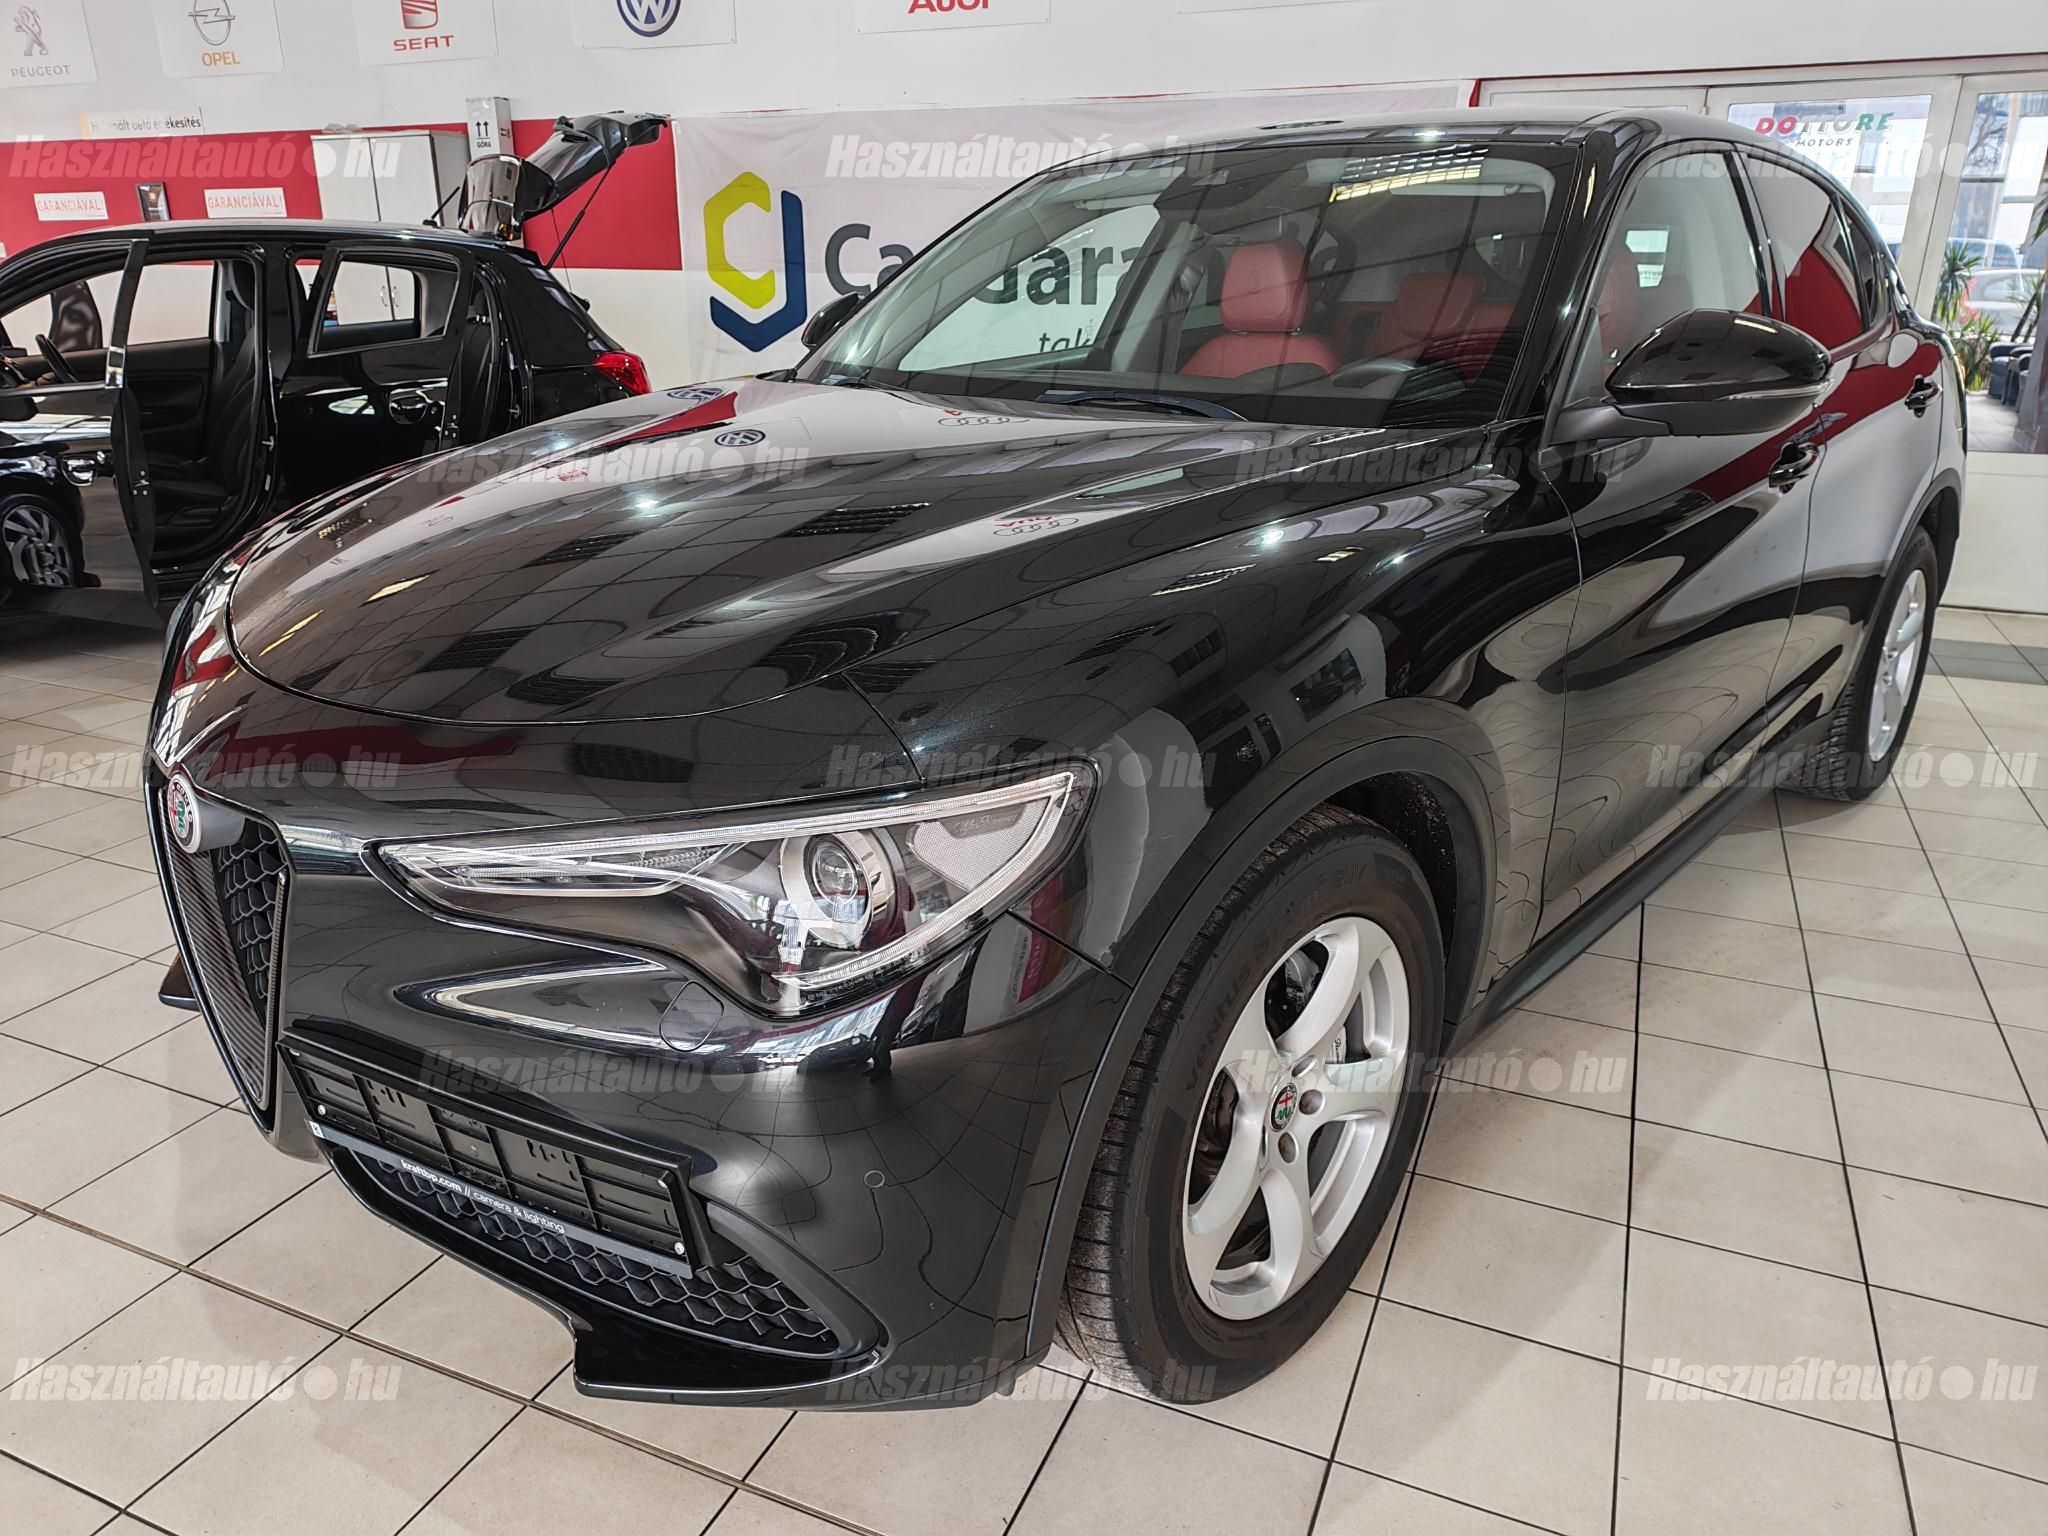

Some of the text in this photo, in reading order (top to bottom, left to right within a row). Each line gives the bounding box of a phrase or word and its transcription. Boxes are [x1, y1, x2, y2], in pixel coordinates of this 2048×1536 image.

[393, 35, 454, 51] SEAT
[202, 51, 241, 66] OPEL
[11, 64, 71, 78] PEUGEOT
[1754, 112, 1895, 135] DOTTORE
[1795, 138, 1854, 148] MOTORS
[208, 191, 283, 209] GARANCIÁVAL!
[401, 1159, 463, 1193] kraftbp.com
[474, 1192, 512, 1213] camera
[513, 1206, 523, 1216] &
[523, 1210, 565, 1234] lighting
